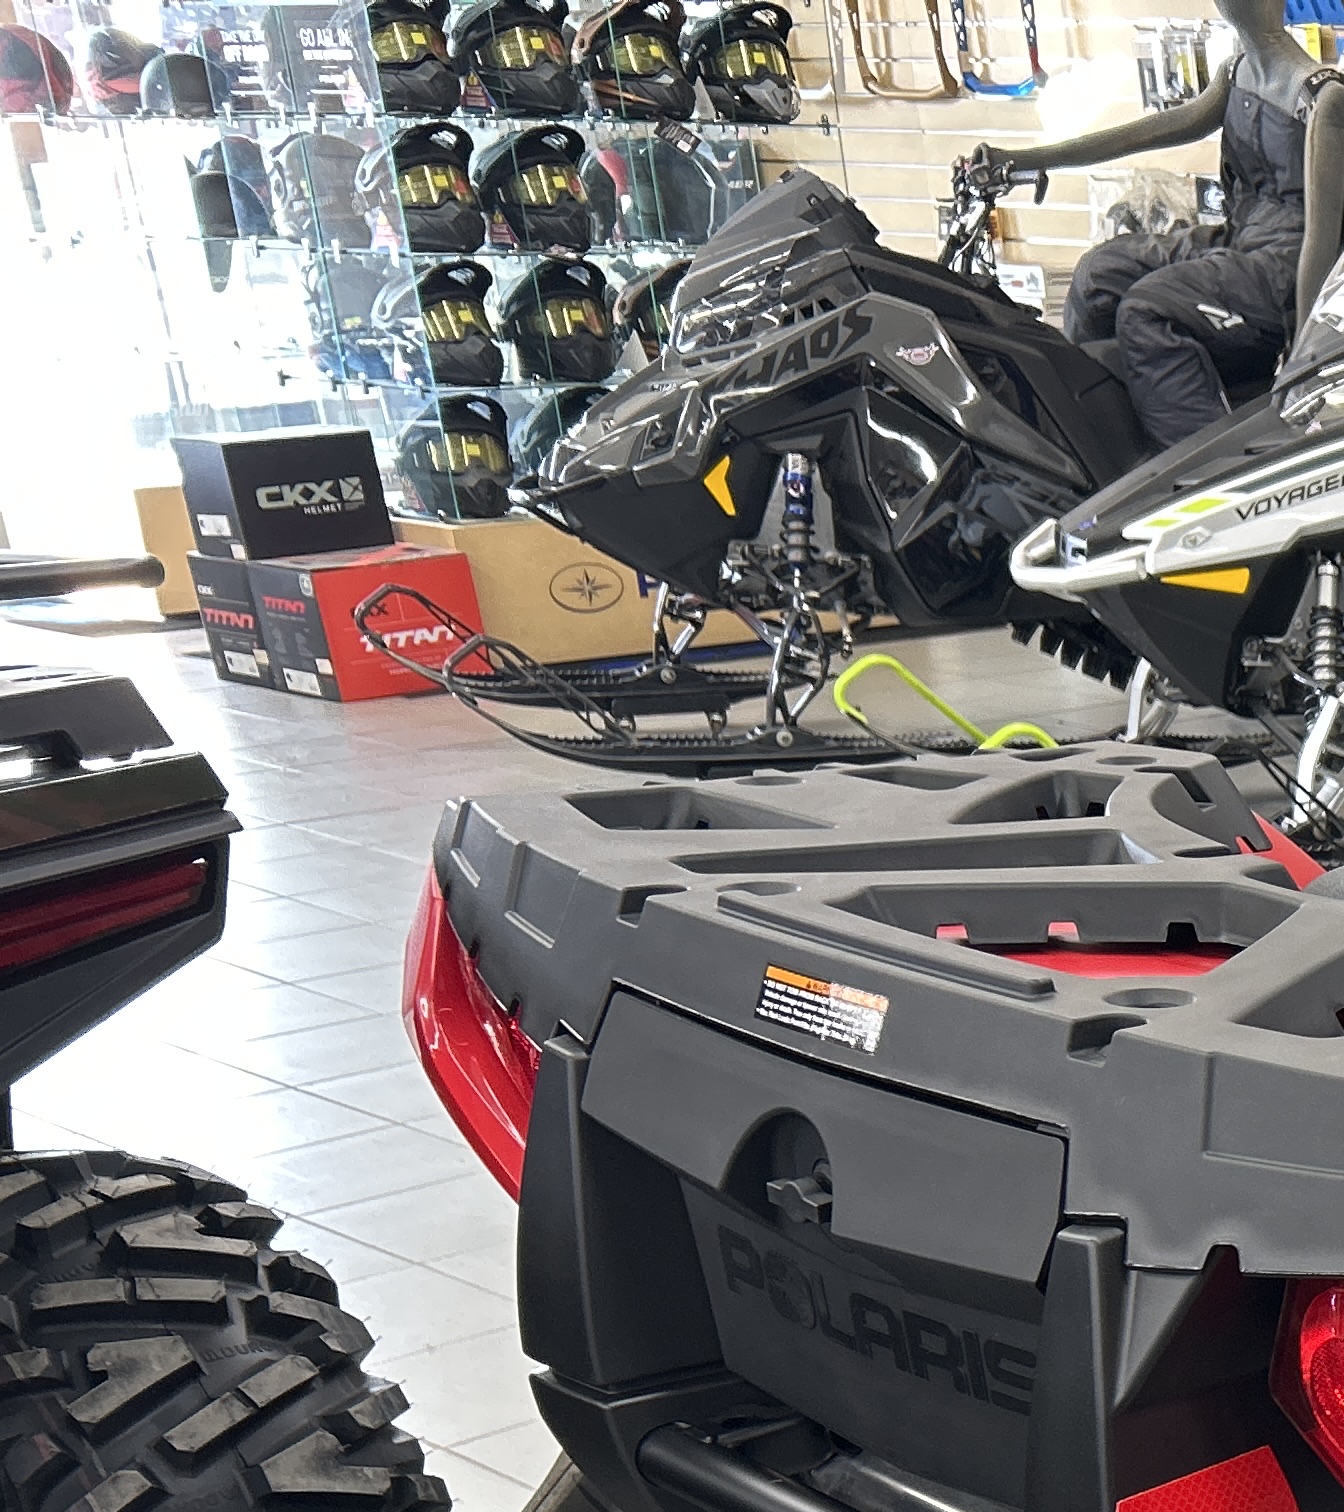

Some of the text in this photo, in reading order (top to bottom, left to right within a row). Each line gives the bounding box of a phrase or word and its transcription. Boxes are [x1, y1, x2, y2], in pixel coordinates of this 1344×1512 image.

[255, 480, 337, 510] CKX
[303, 502, 342, 515] HELMET
[718, 1223, 1037, 1417] POLARIS
